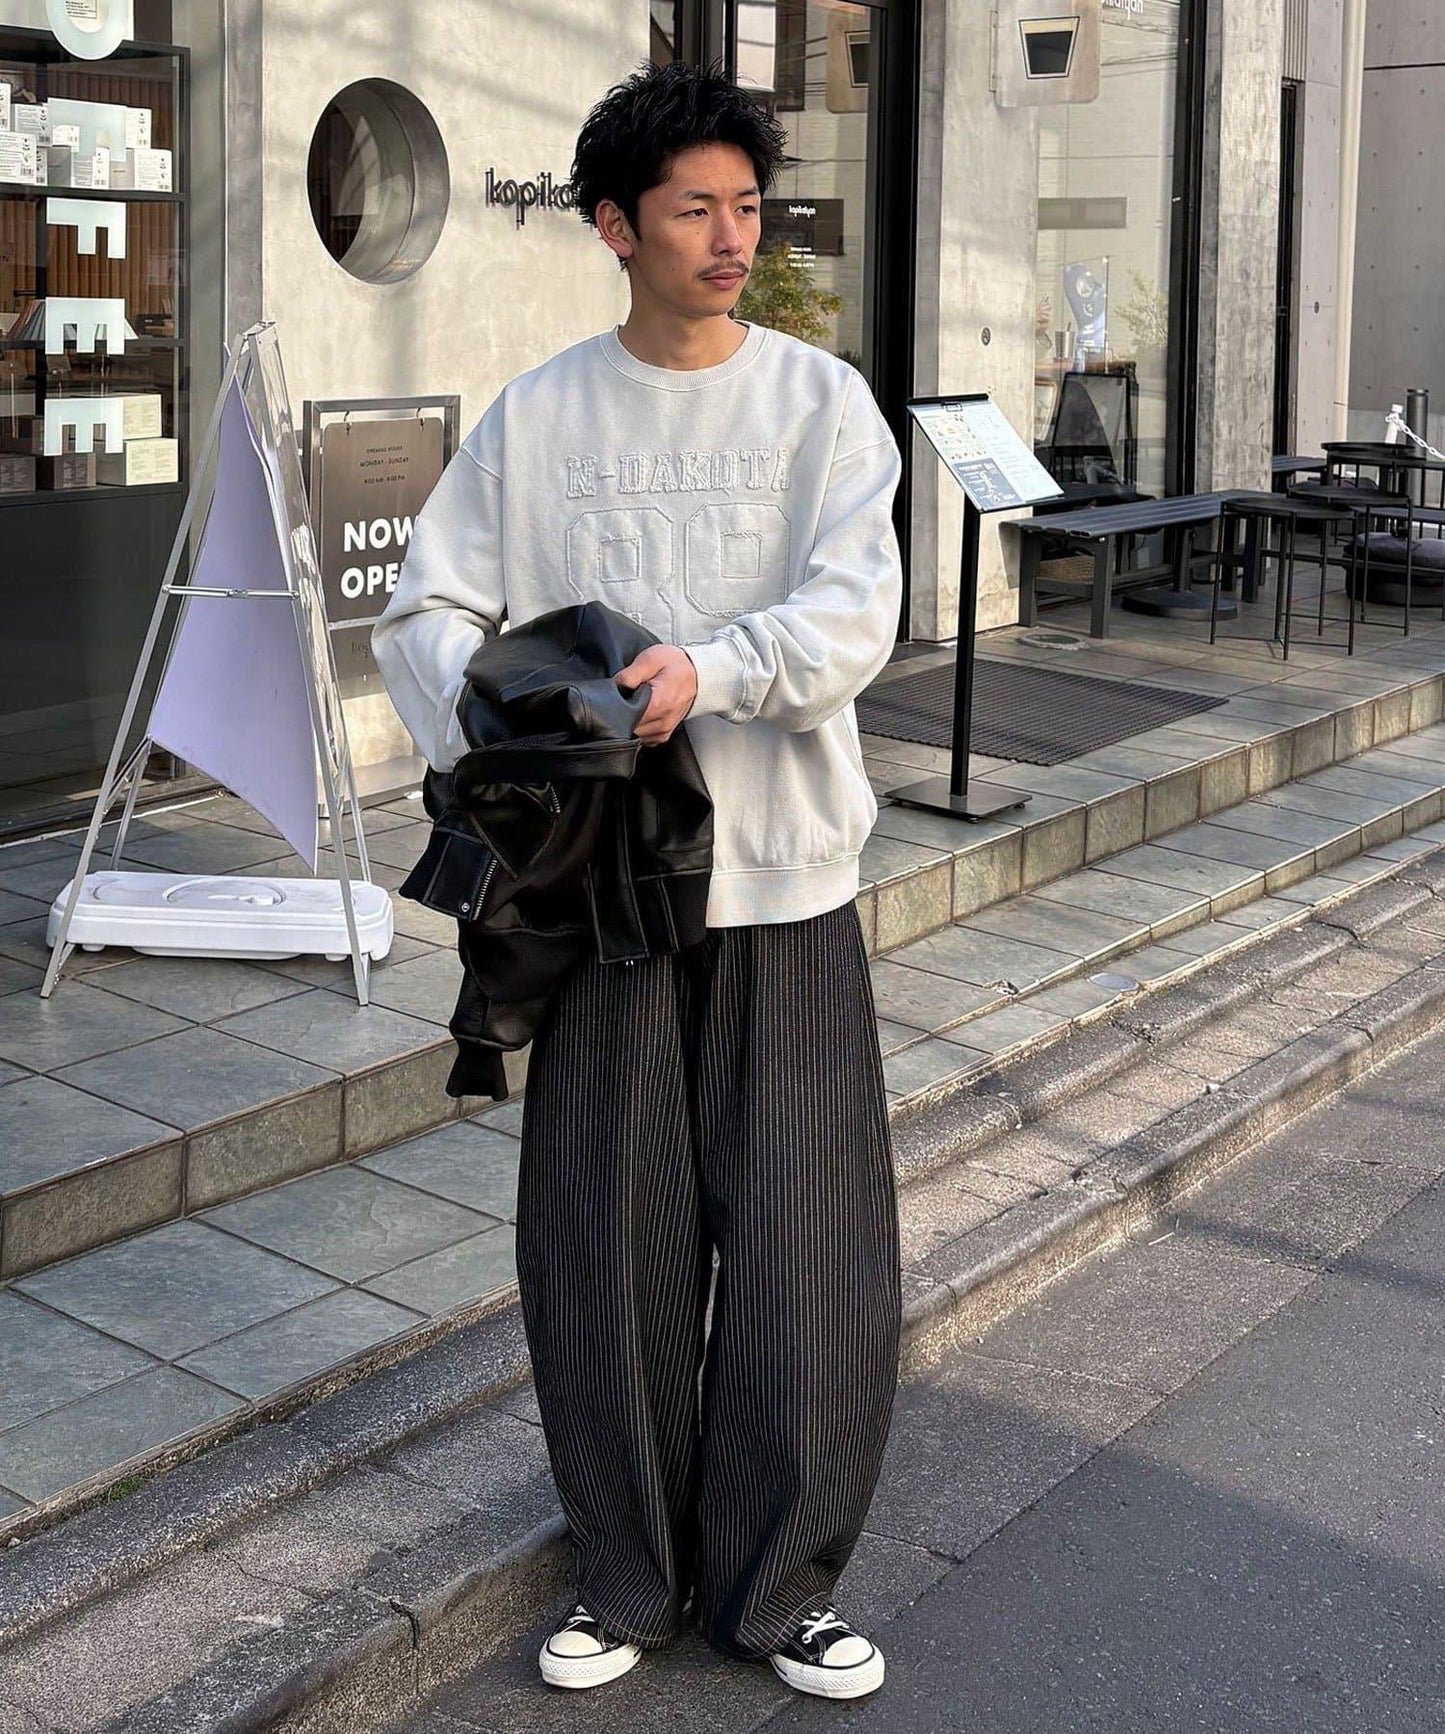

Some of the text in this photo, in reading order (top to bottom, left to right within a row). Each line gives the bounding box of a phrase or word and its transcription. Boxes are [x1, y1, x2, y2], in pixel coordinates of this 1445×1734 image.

[566, 449, 791, 499] N-DAKOTA
[343, 515, 419, 553] NOW
[340, 561, 404, 599] OPE
